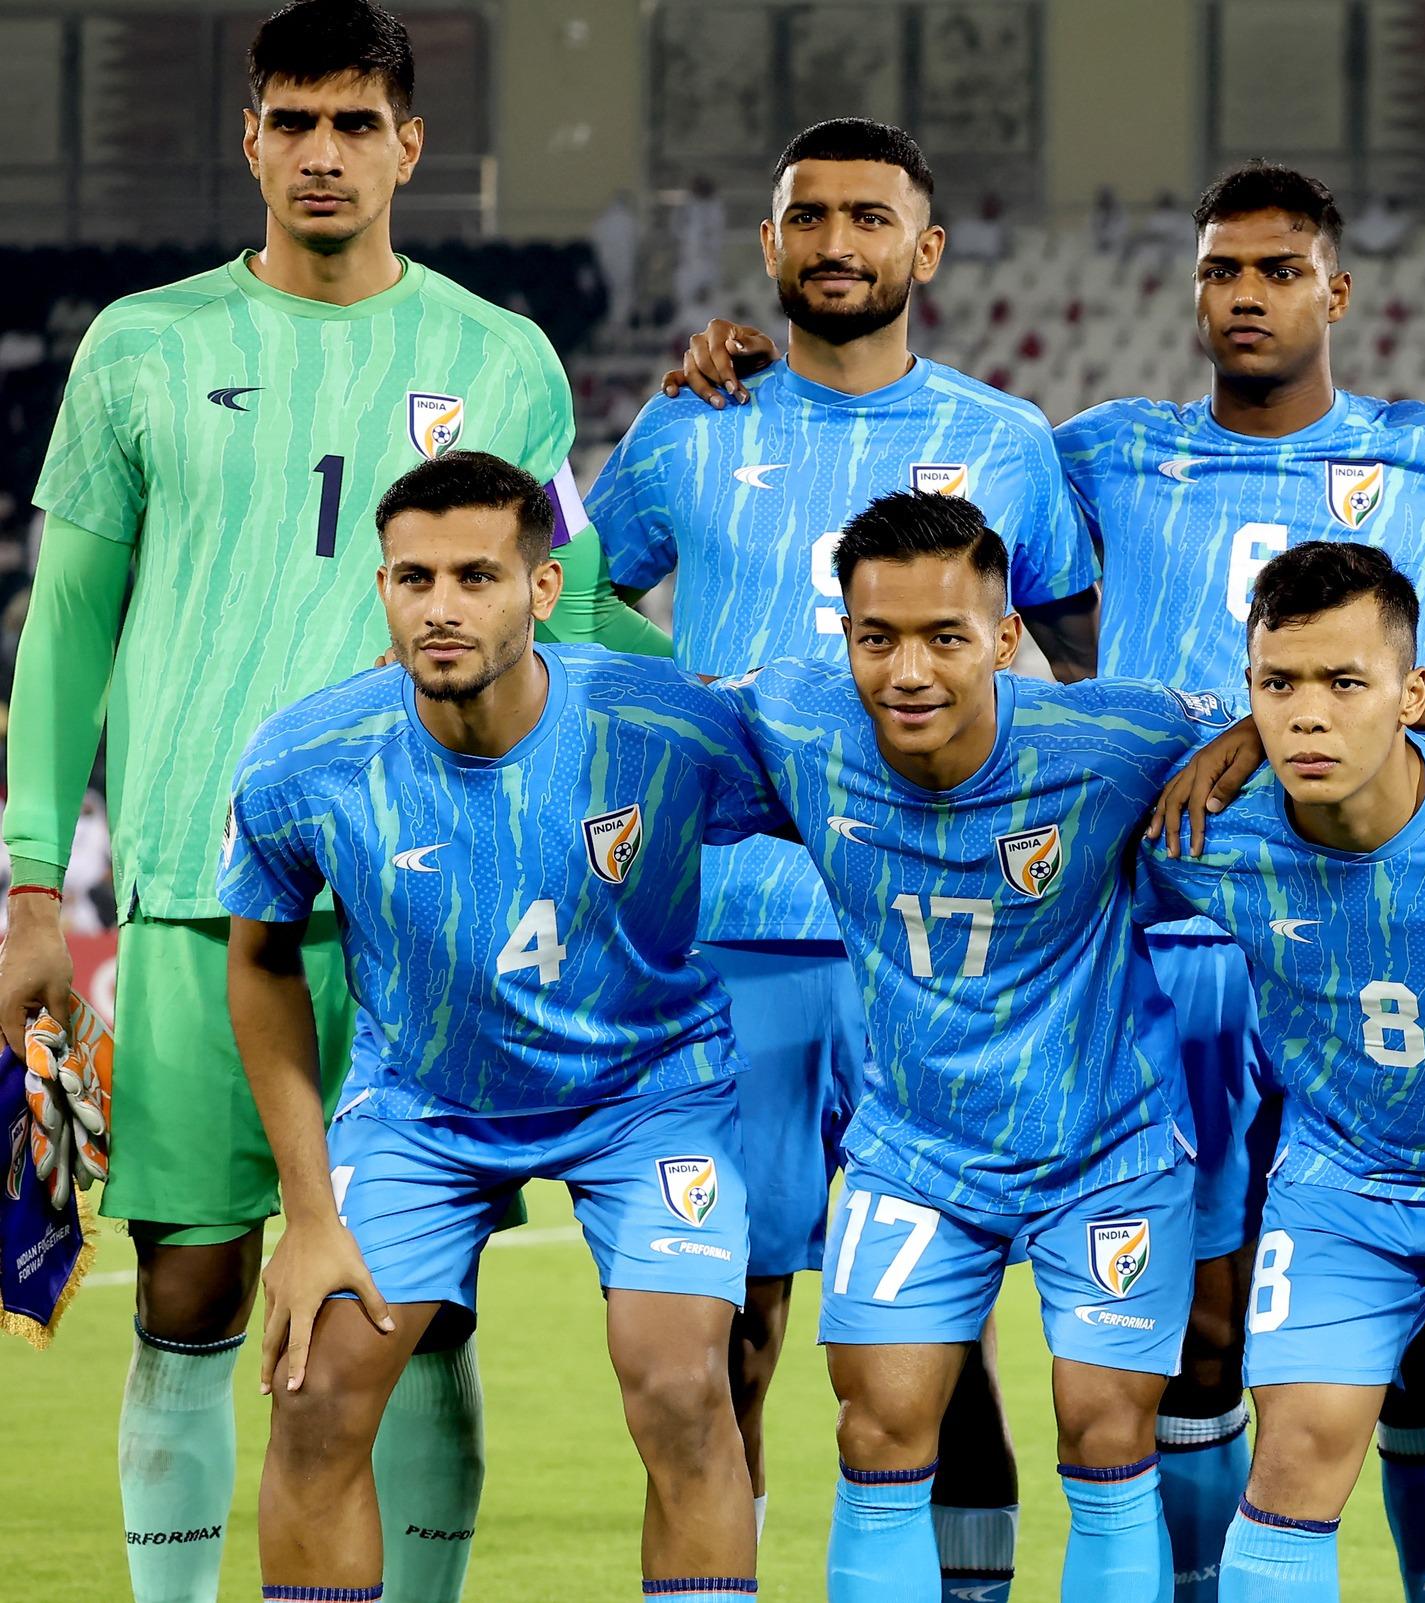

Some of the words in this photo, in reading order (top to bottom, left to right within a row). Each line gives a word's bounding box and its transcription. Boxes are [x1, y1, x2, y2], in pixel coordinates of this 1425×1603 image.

[417, 400, 446, 411] INDIA
[920, 472, 950, 481] INDIA
[1335, 469, 1364, 477] INDIA
[314, 455, 344, 558] 1
[1226, 523, 1287, 621] 6
[593, 820, 624, 835] INDIA
[1008, 839, 1041, 853] INDIA
[497, 901, 567, 985] 4
[892, 894, 994, 978] 17
[1359, 980, 1425, 1069] 8
[668, 1165, 699, 1175] INDIA
[1098, 1229, 1130, 1240] INDIA
[679, 1241, 731, 1261] PERFORMAX
[832, 1190, 940, 1303] 17
[1249, 1229, 1294, 1333] 8
[1098, 1311, 1156, 1331] PERFORMAX
[125, 1525, 221, 1545] ERFORMAX
